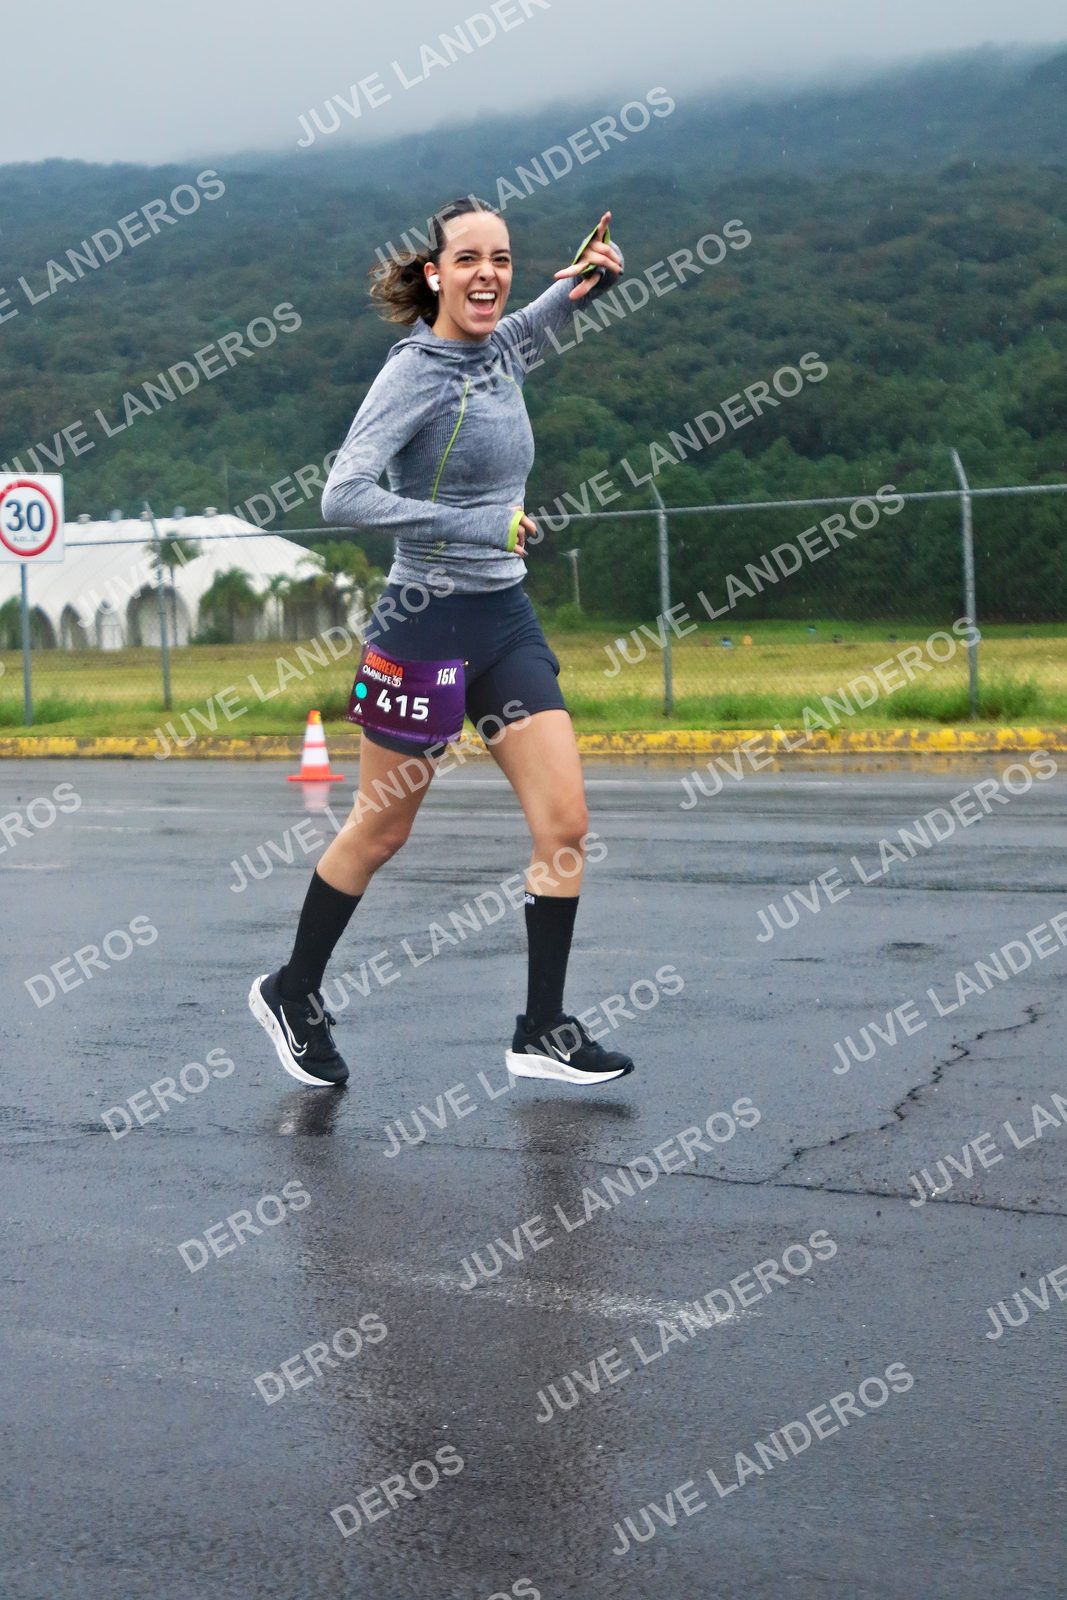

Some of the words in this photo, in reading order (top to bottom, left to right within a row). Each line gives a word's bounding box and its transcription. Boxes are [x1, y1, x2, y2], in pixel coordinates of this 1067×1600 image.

[5, 499, 46, 532] 30
[362, 664, 392, 684] OMNILIFE
[365, 651, 404, 678] CARRERA
[376, 688, 430, 720] 415
